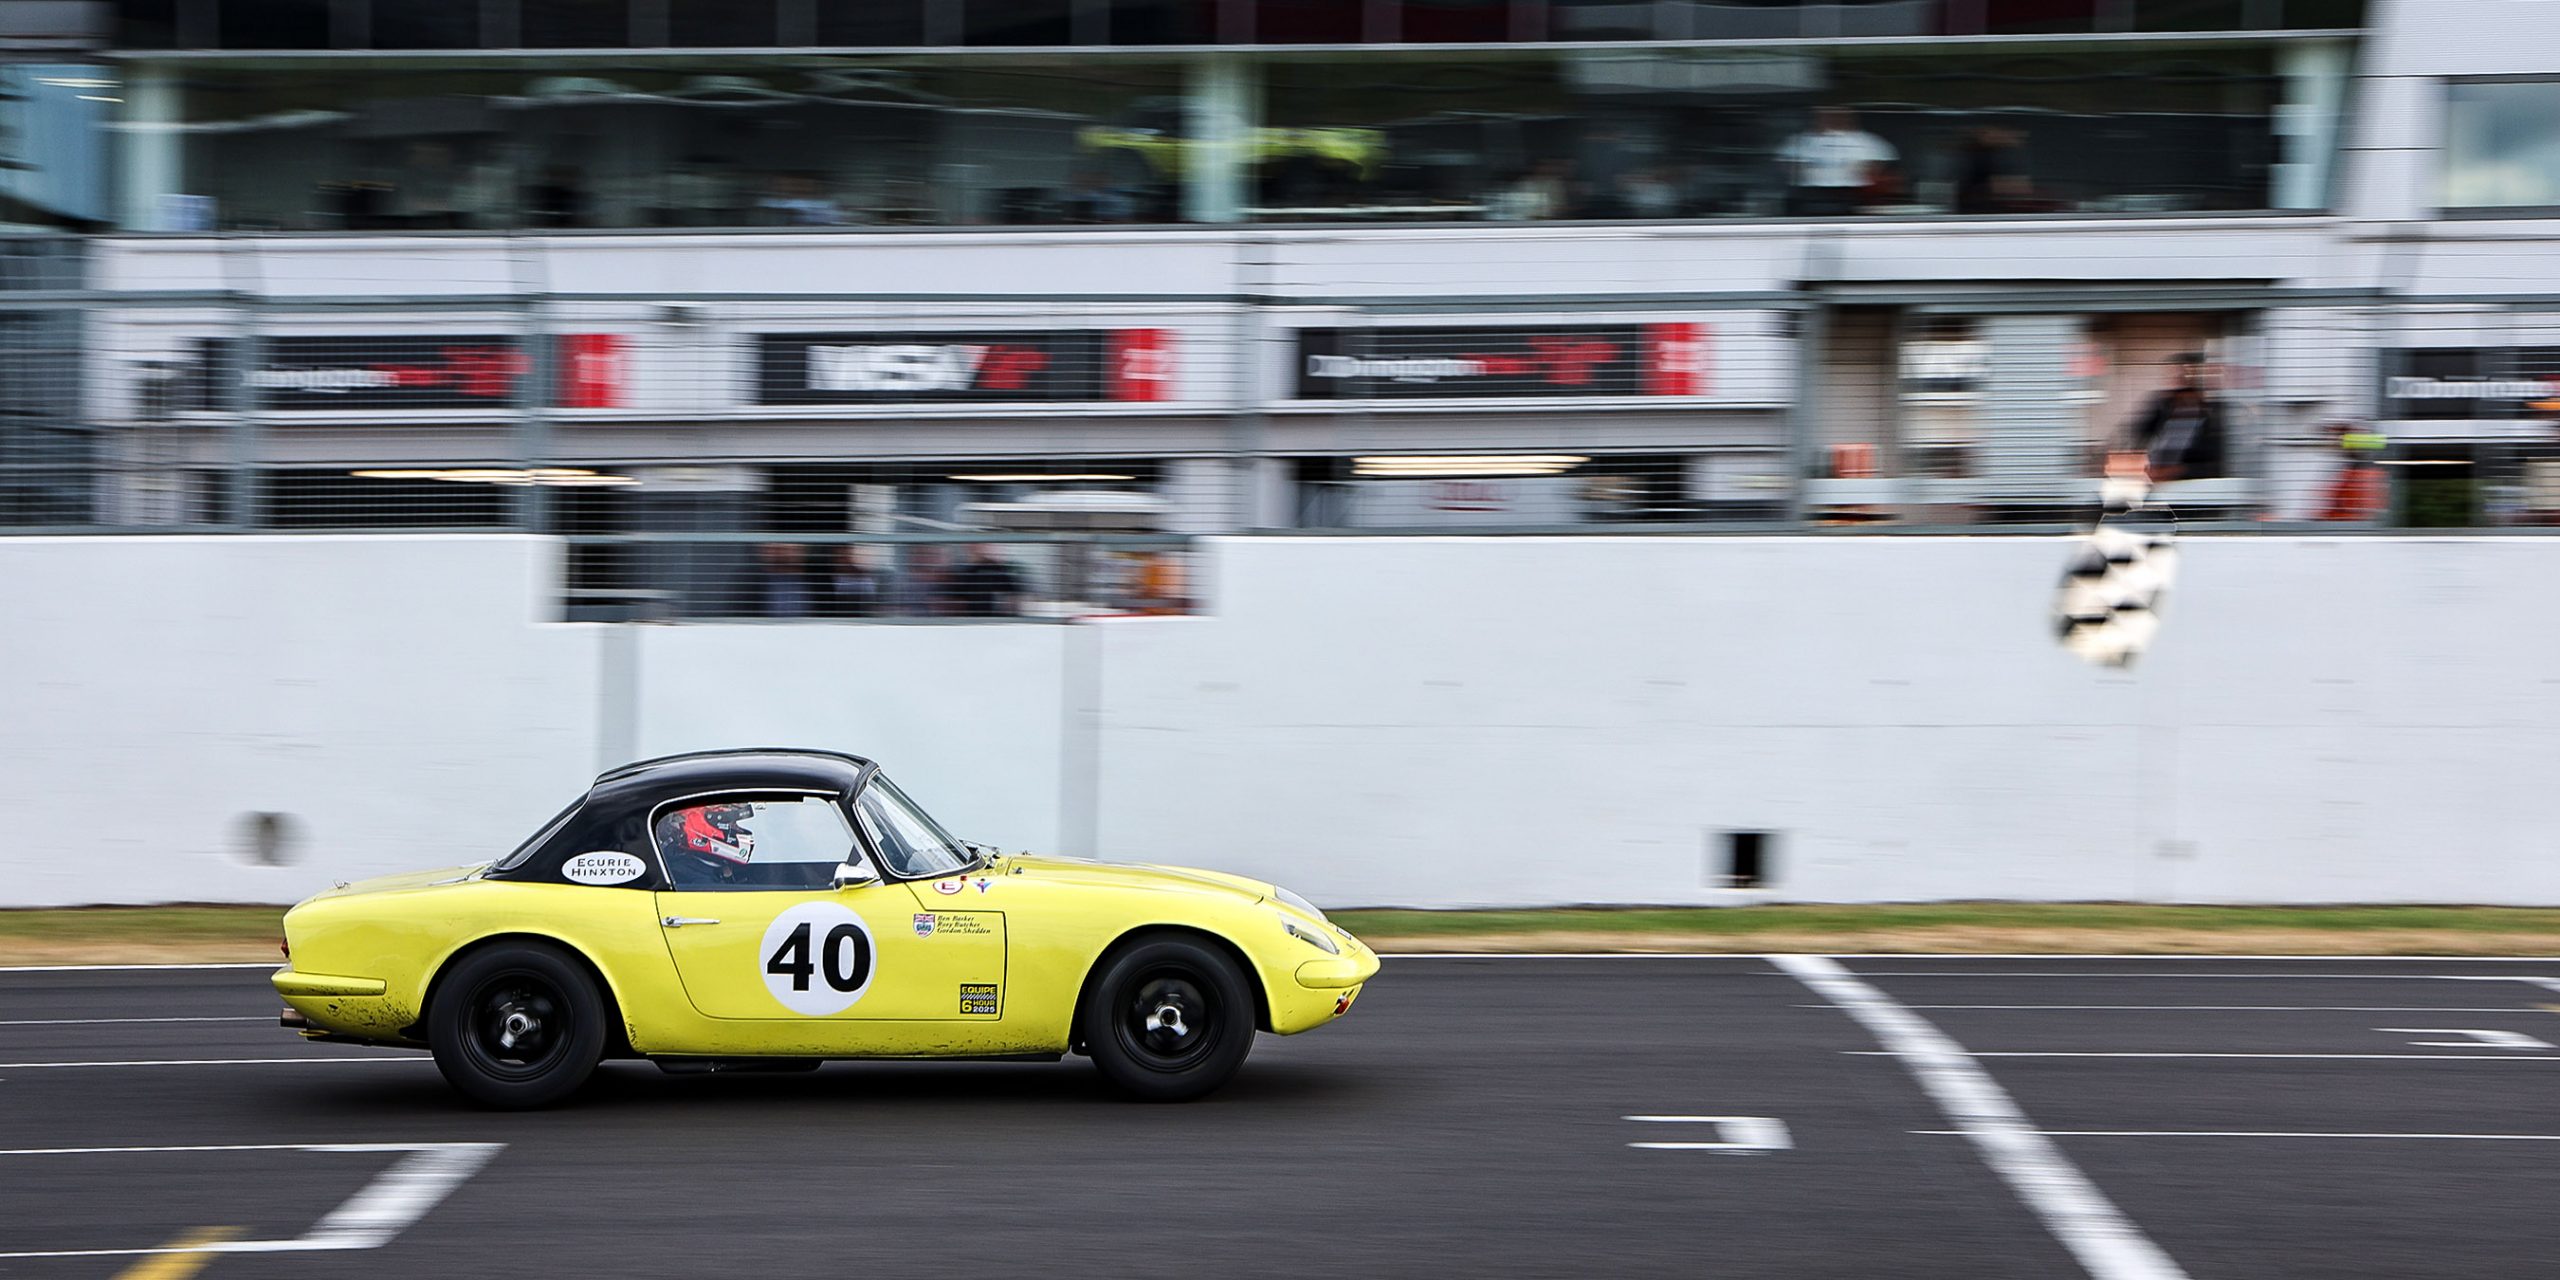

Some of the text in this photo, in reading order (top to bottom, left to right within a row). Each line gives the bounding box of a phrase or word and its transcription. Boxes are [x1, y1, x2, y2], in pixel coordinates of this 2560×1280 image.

[577, 858, 631, 867] ECURIE
[571, 868, 637, 877] HINXTON
[767, 922, 871, 993] 40
[961, 986, 996, 994] EQUIPE
[961, 1000, 973, 1013] 6
